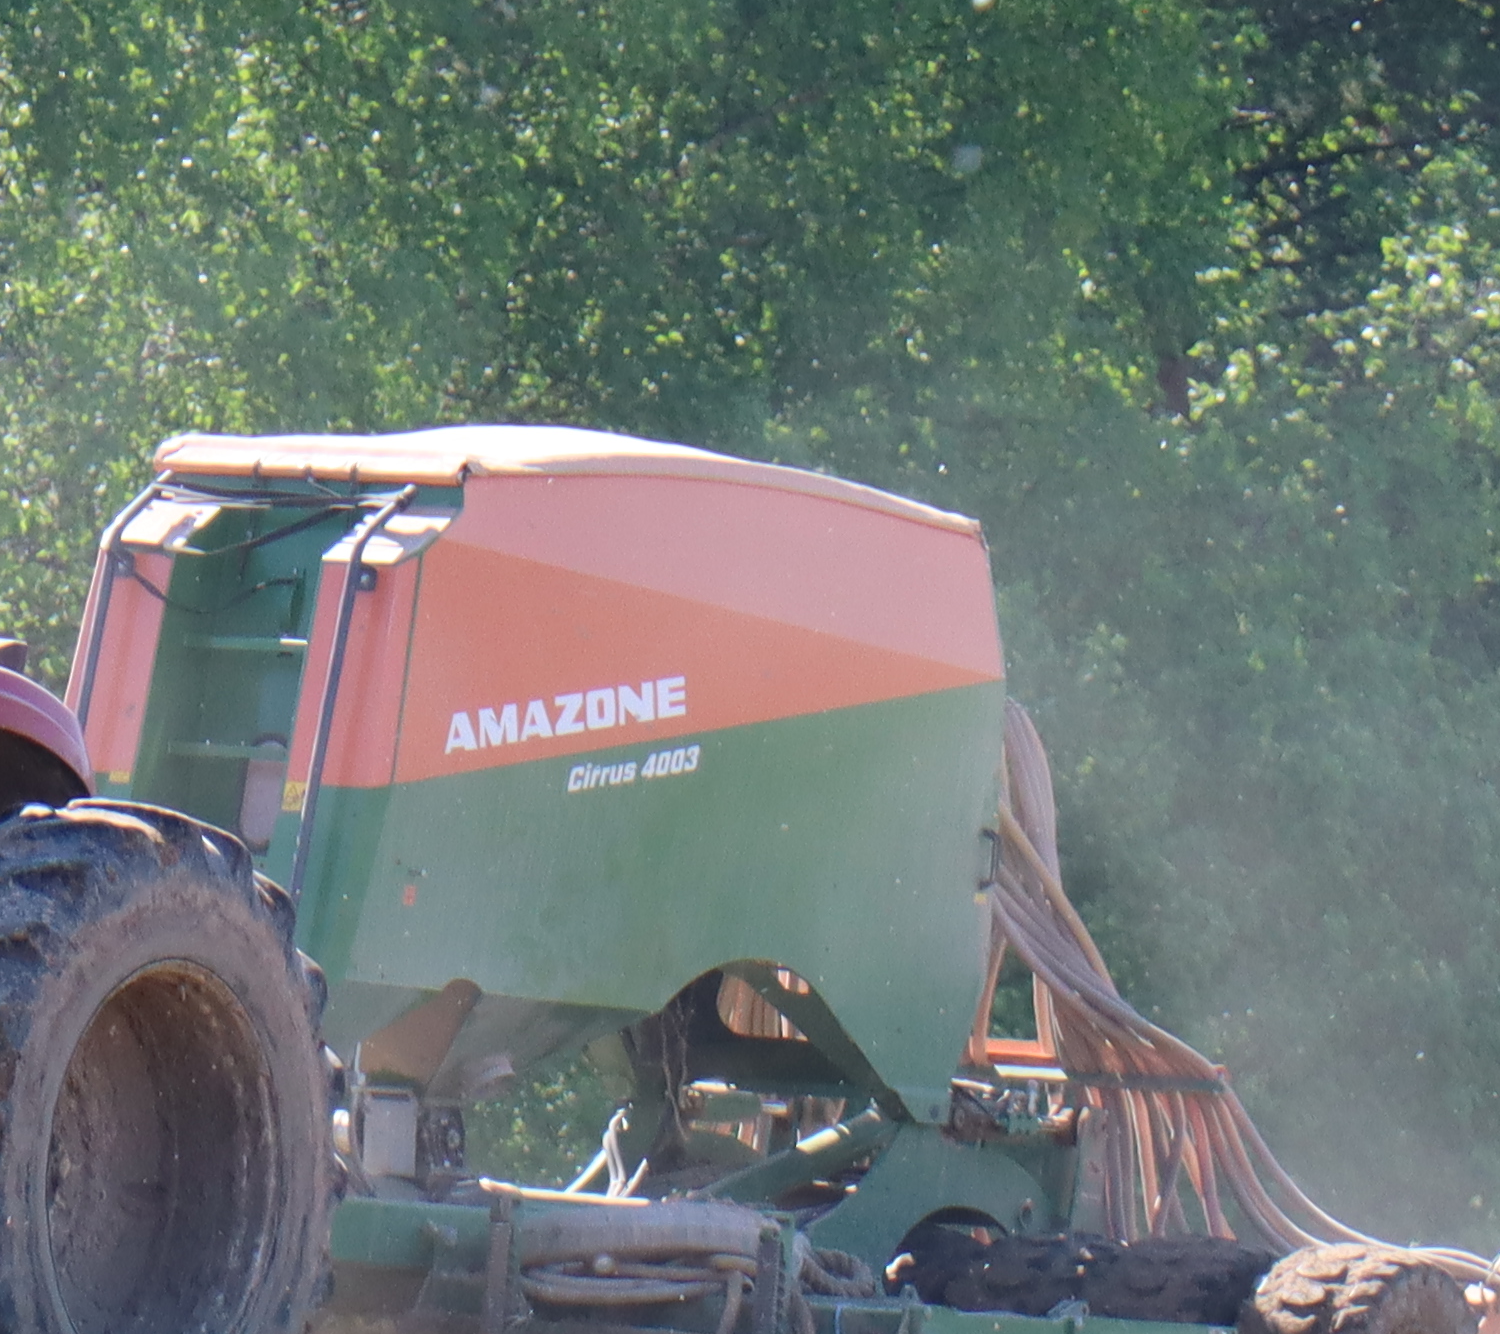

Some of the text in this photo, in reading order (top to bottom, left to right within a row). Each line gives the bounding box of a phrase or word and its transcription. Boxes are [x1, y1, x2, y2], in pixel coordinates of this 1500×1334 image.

[444, 675, 687, 755] AMAZONE
[567, 744, 701, 793] Cirrus 4003
